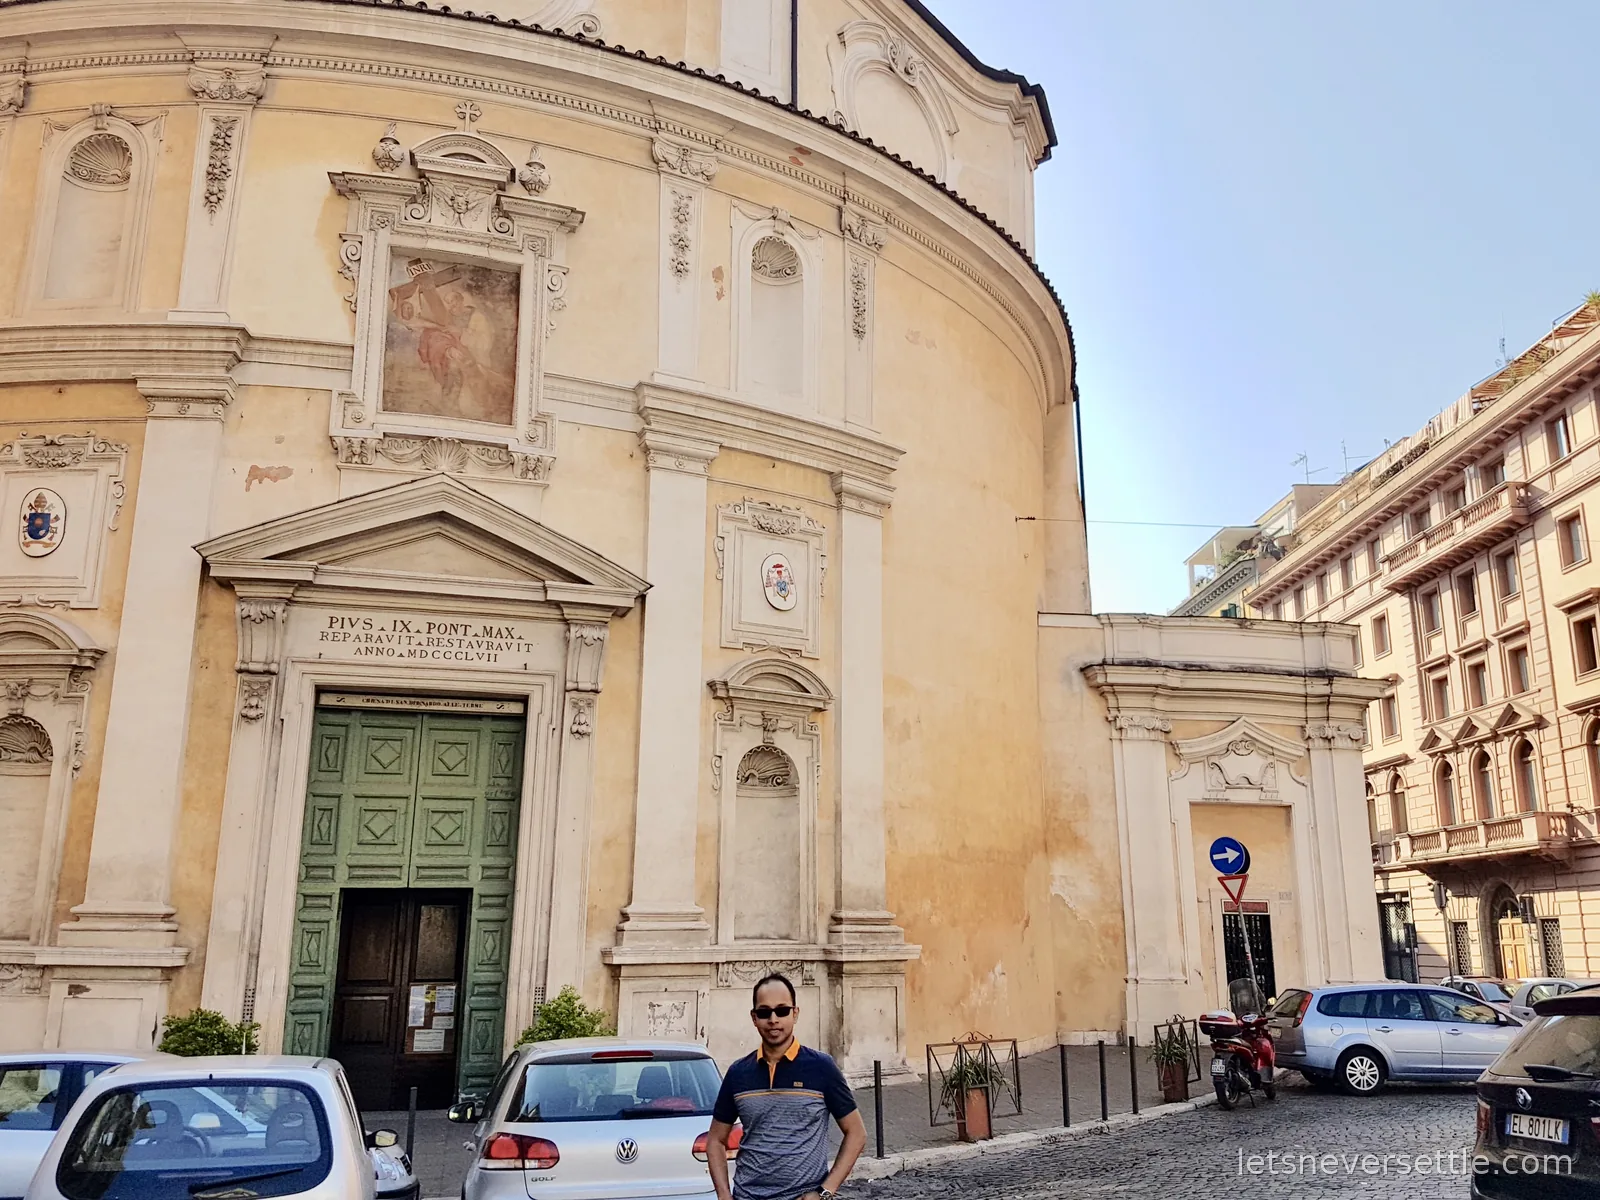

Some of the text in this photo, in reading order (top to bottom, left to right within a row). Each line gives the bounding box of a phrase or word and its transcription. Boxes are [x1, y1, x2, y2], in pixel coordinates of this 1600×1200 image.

[327, 616, 515, 640] PIVS IX PONT MAX
[319, 631, 534, 653] REPARAVIT RESTAVRAVIT
[353, 646, 499, 663] ANNO MDCCCLVII
[1512, 1114, 1561, 1141] EL 801LK
